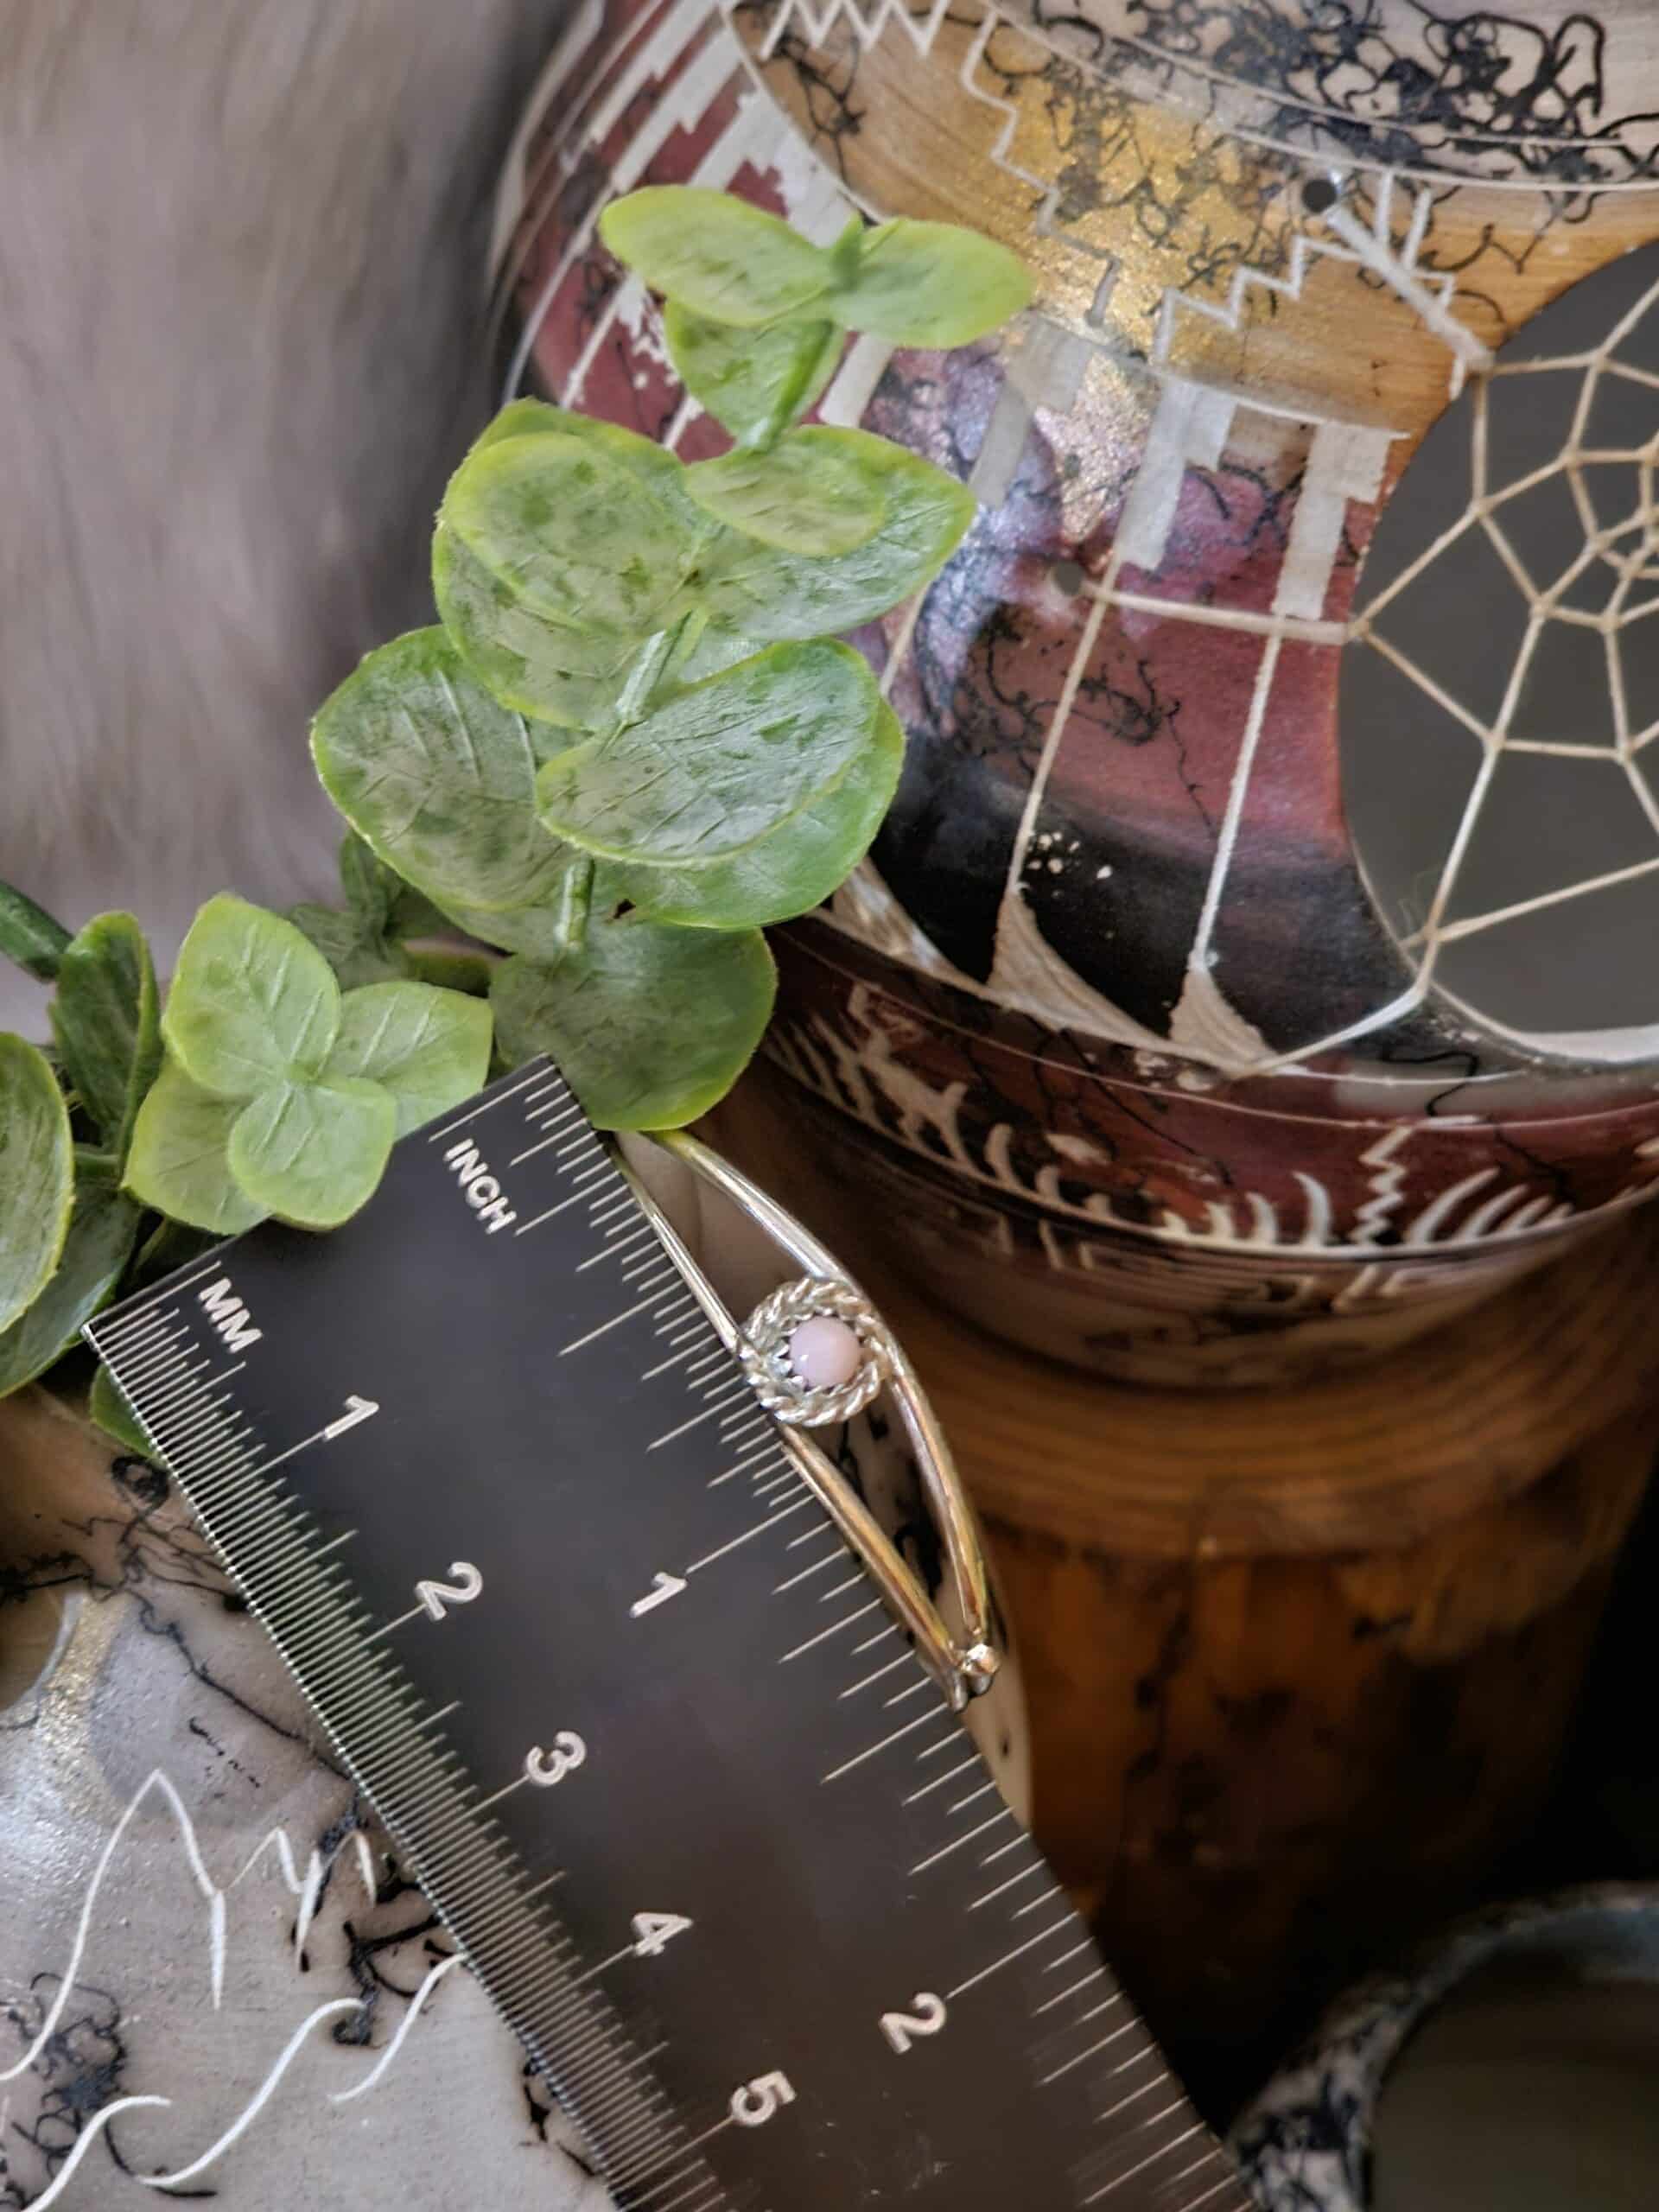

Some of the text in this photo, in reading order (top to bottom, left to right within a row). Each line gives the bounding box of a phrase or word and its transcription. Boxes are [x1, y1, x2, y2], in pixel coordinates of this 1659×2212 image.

[443, 1138, 518, 1235] INCH
[197, 1277, 263, 1354] MM
[322, 1395, 379, 1441] 1
[415, 1560, 484, 1622] 2
[629, 1571, 689, 1619] 1
[524, 1730, 588, 1787] 3
[631, 1911, 695, 1956] 4
[879, 1991, 948, 2055] 2
[728, 2069, 797, 2128] 5
